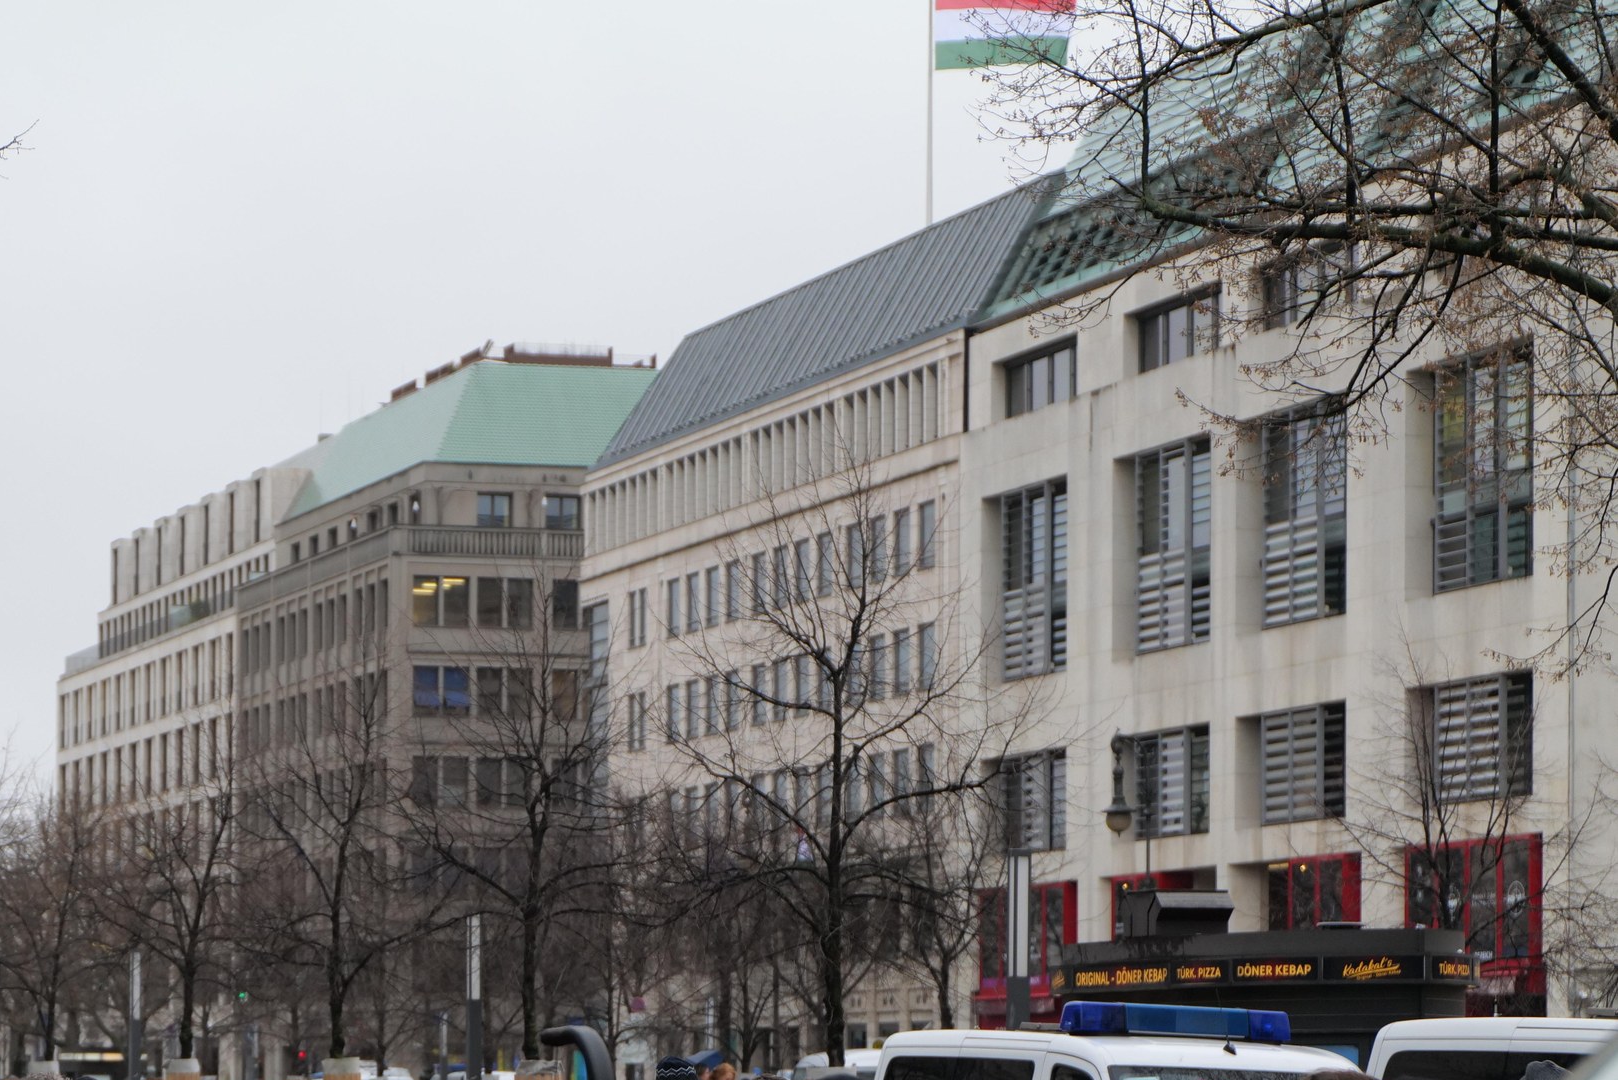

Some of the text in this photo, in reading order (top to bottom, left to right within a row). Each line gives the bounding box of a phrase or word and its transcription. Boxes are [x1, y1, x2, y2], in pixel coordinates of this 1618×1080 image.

[1076, 971, 1110, 987] ORIGINAL
[1116, 966, 1142, 985] DÖNER
[1143, 967, 1168, 983] KEBAP
[1177, 965, 1221, 979] TÜRK. PIZZA
[1237, 962, 1312, 977] DÖNER KEBAP
